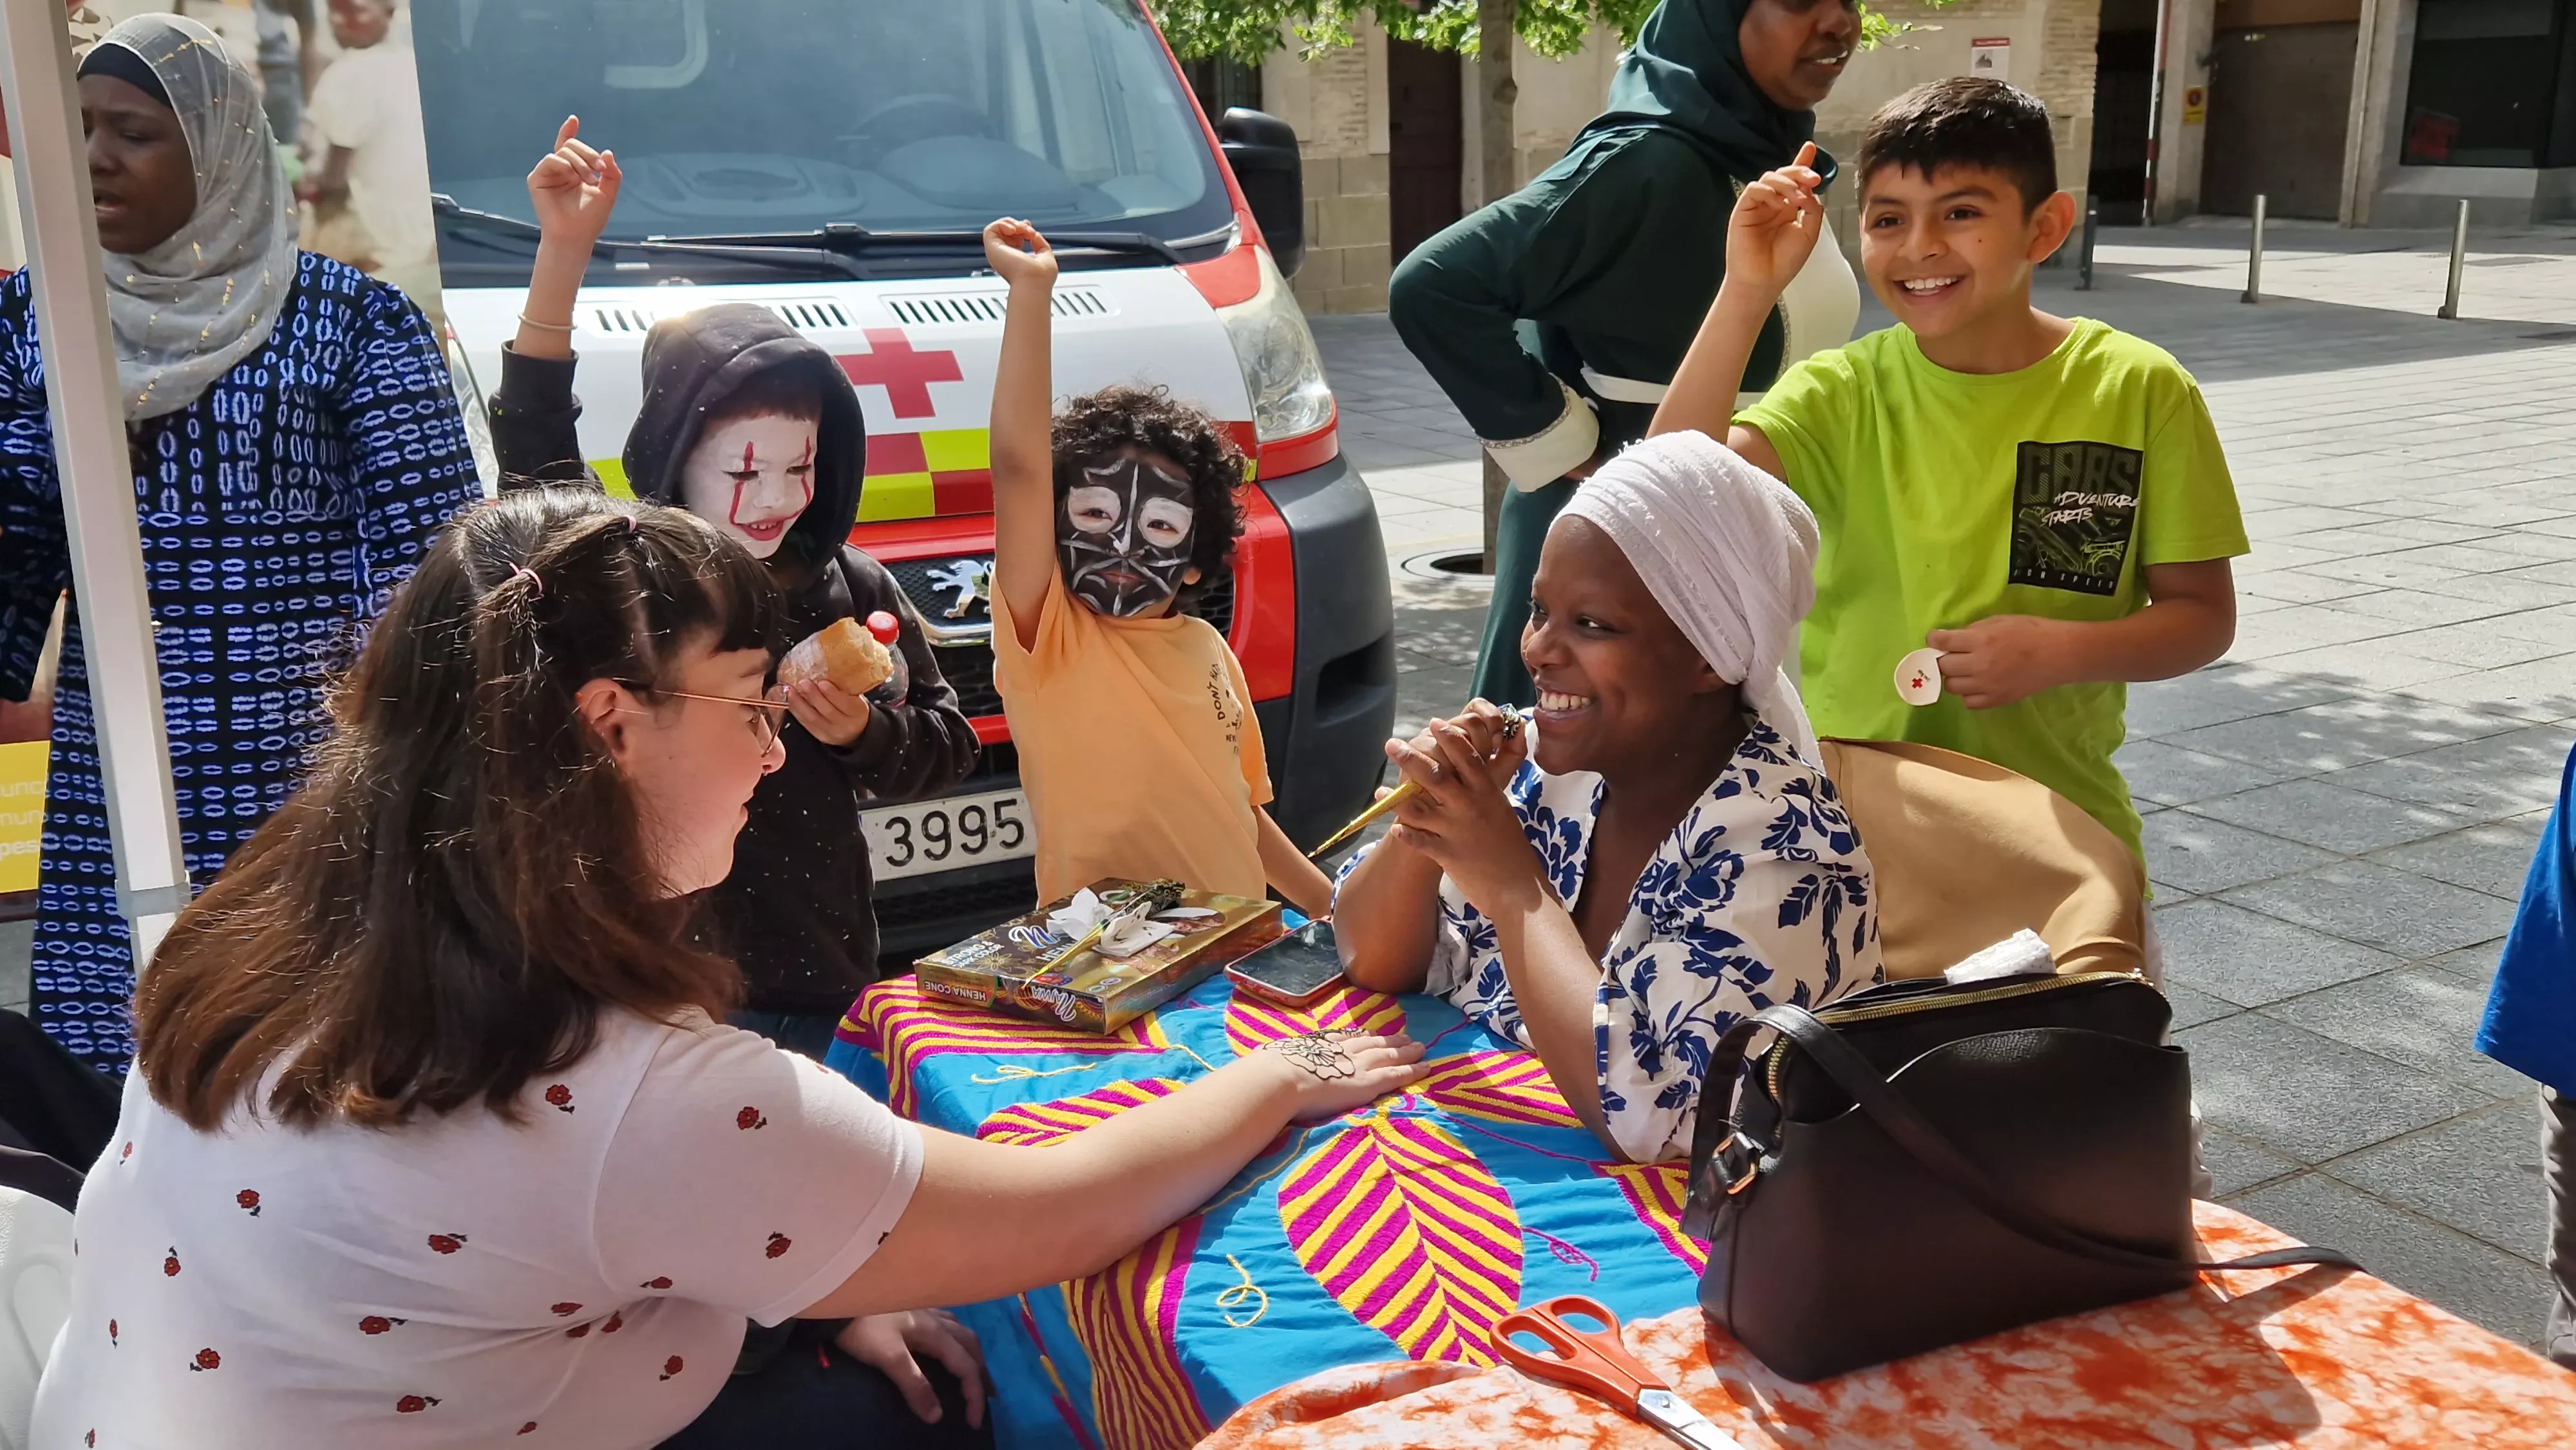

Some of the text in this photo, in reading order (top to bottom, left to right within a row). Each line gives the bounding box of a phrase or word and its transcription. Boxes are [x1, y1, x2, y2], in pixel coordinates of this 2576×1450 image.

[2022, 447, 2137, 504] CARS
[2040, 507, 2093, 527] STARTS
[884, 798, 1025, 867] 3995
[924, 981, 987, 1001] HENNA CONE
